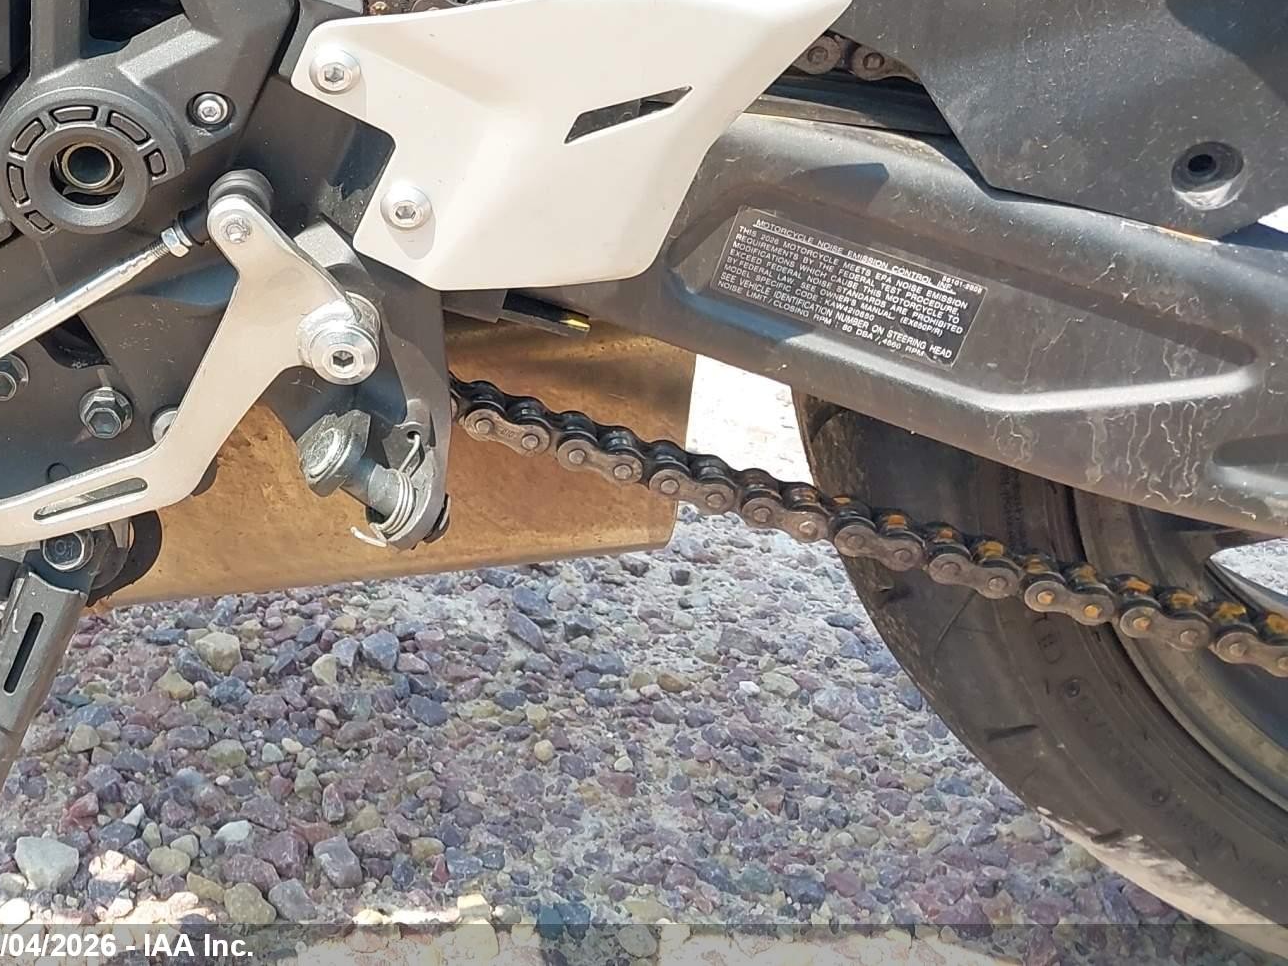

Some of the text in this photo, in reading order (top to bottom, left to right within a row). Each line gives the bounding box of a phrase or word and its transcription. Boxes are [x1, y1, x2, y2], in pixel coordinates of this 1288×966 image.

[724, 264, 751, 278] MODEL
[755, 275, 792, 292] SPECIFIC
[727, 257, 737, 265] BY
[739, 261, 774, 278] FEDERAL
[801, 282, 816, 292] SEE
[733, 241, 960, 324] MODIFICATIONS WHICH CAUSE THIS MOTORCYCLE TO
[736, 234, 800, 261] REQUIREMENTS
[803, 257, 815, 266] BY
[818, 262, 835, 273] THE
[838, 269, 876, 287] FEDERAL
[880, 283, 902, 296] TEST
[739, 226, 758, 238] THIS
[783, 241, 840, 266] MOTORCYCLE
[843, 261, 872, 277] MEETS
[875, 272, 893, 284] EPA
[896, 279, 923, 294] NOISE
[926, 290, 969, 309] EMISSION
[756, 219, 814, 244] MOTORCYCLE
[817, 240, 844, 255] NOISE
[847, 250, 889, 270] EMISSION
[891, 265, 934, 285] CONTROL
[718, 281, 743, 294] NOISE
[814, 314, 832, 325] RPM
[905, 346, 924, 357] RPM
[721, 272, 953, 359] SEE VEHICLE IDENTIFICATION NUMBER ON STEERING HEAD
[730, 249, 964, 334] EXCEED FEDERAL NOISE STANDARDS ARE PROHIBITED
